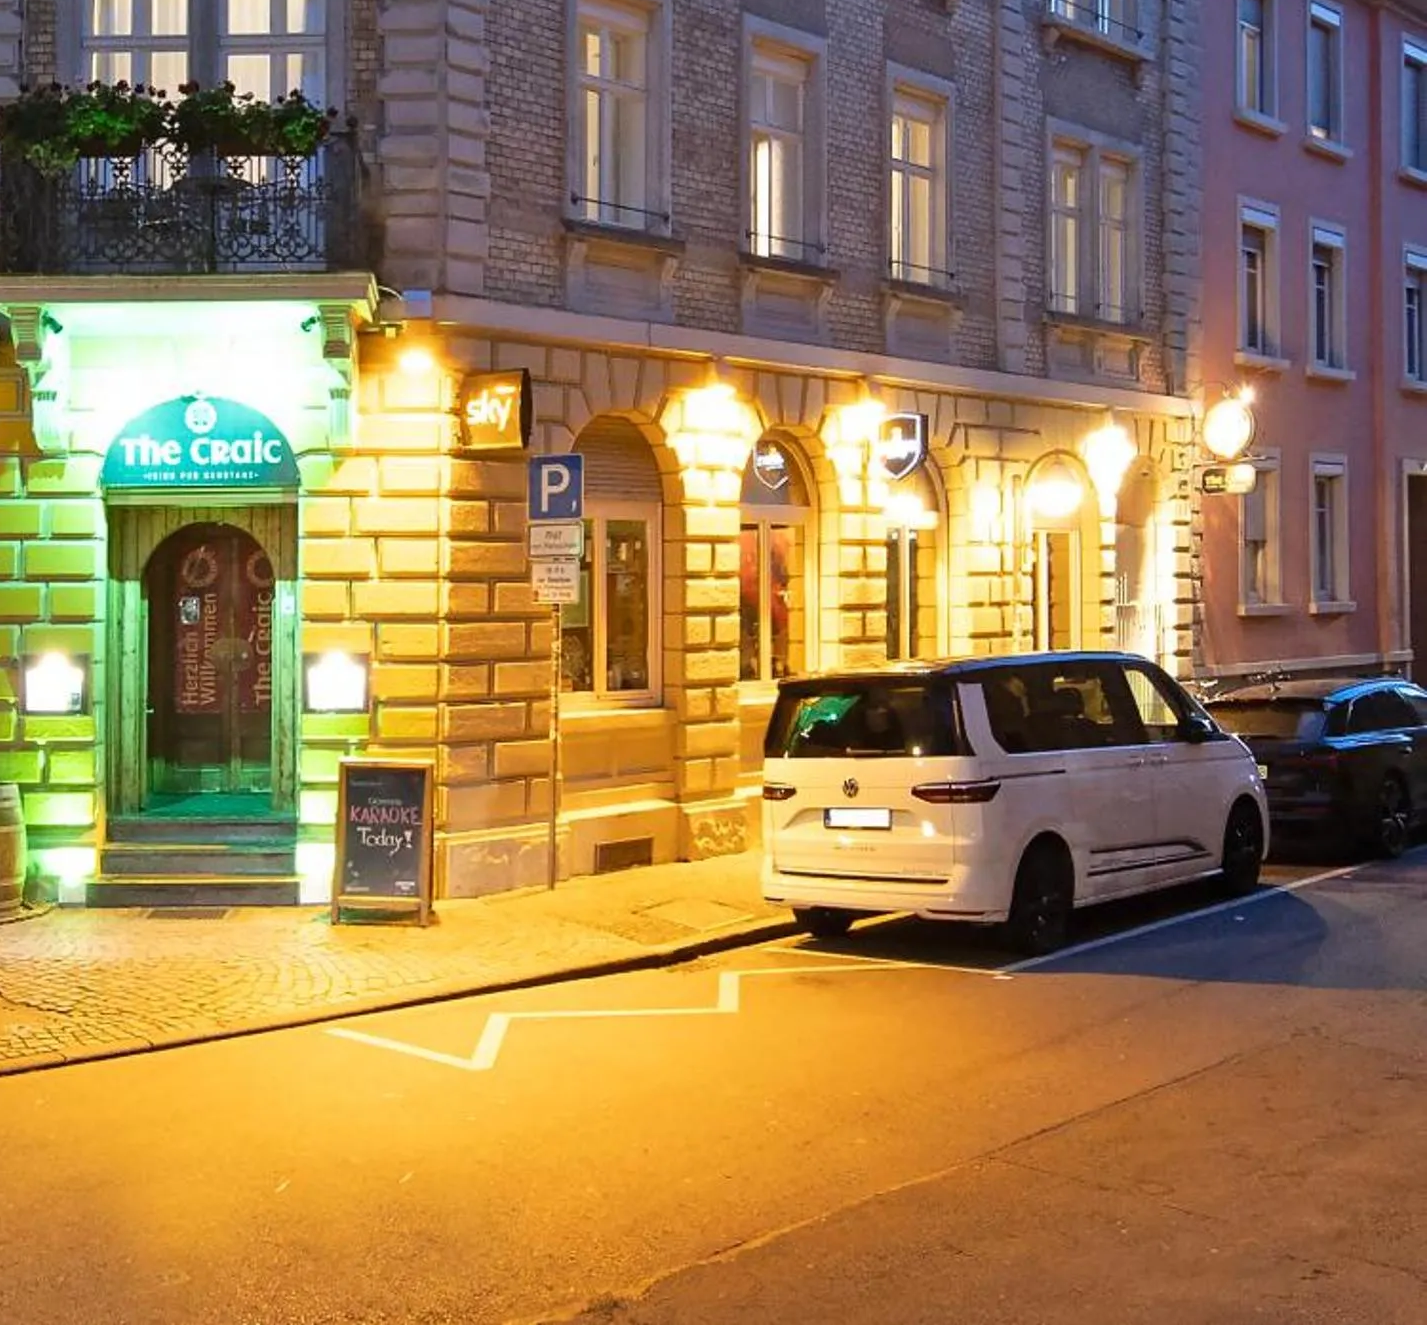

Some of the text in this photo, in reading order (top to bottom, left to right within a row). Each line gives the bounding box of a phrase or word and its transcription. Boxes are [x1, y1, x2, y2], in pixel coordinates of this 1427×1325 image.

[466, 390, 512, 432] sky
[120, 434, 182, 467] The
[541, 464, 570, 513] P
[350, 804, 421, 825] KARAOKE
